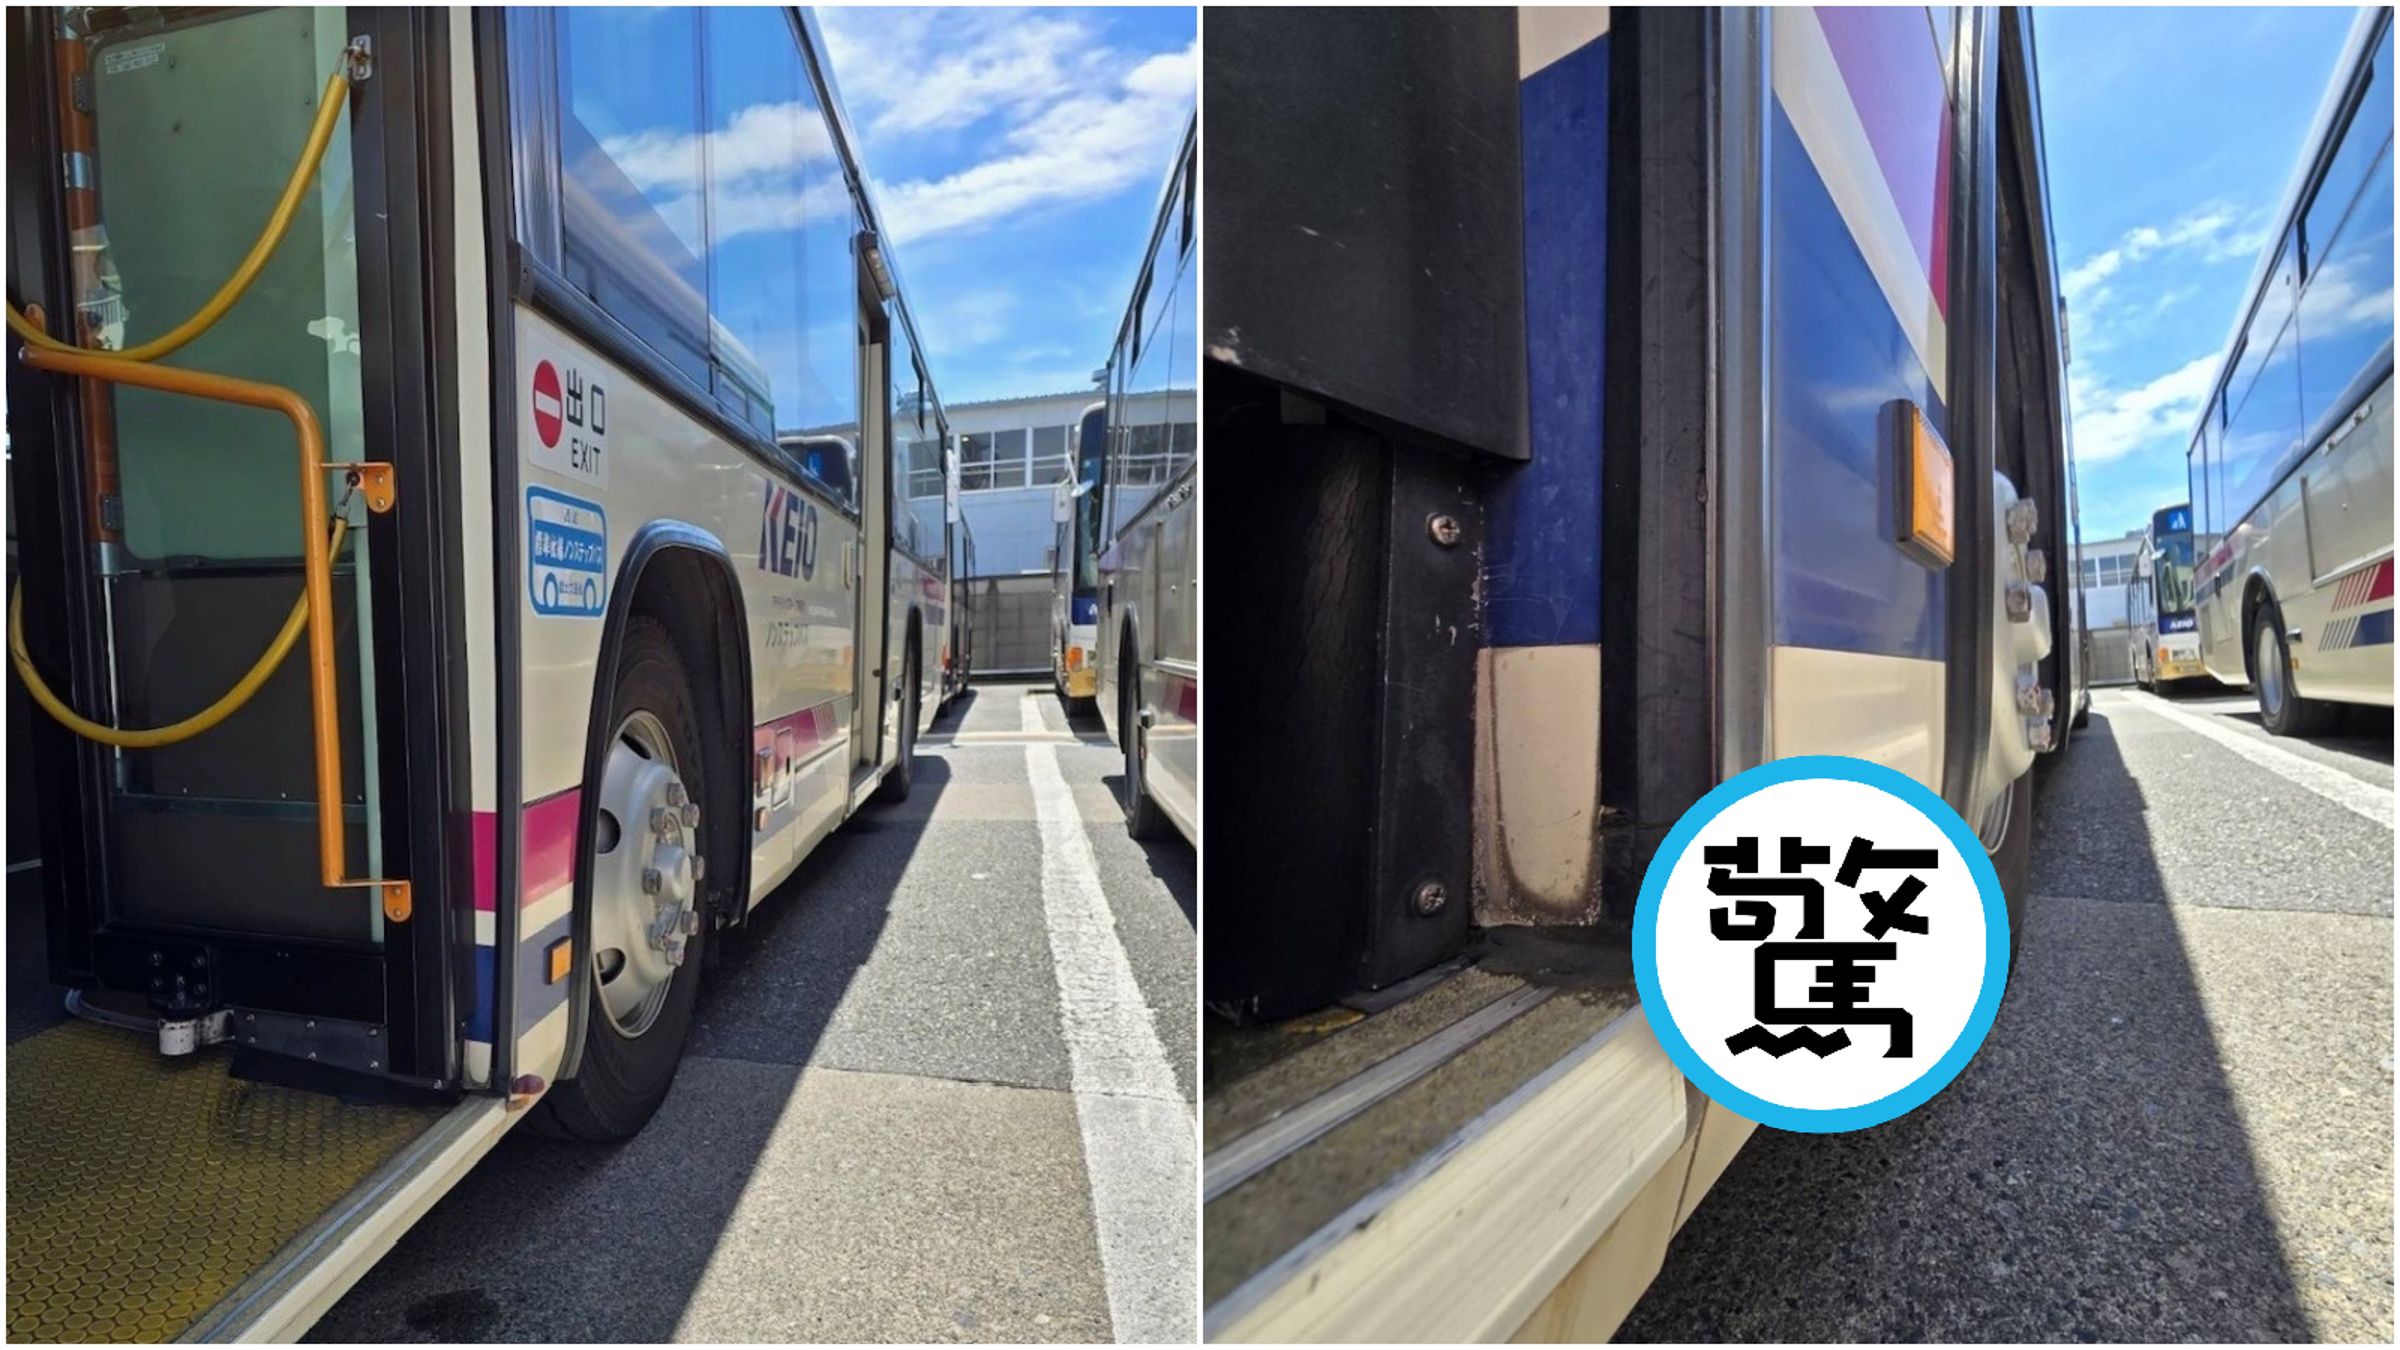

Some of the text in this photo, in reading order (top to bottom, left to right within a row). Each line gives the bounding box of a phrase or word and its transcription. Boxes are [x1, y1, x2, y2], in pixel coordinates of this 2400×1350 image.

[566, 368, 605, 436] 出口
[572, 438, 601, 476] EXIT
[758, 478, 818, 581] KEIO
